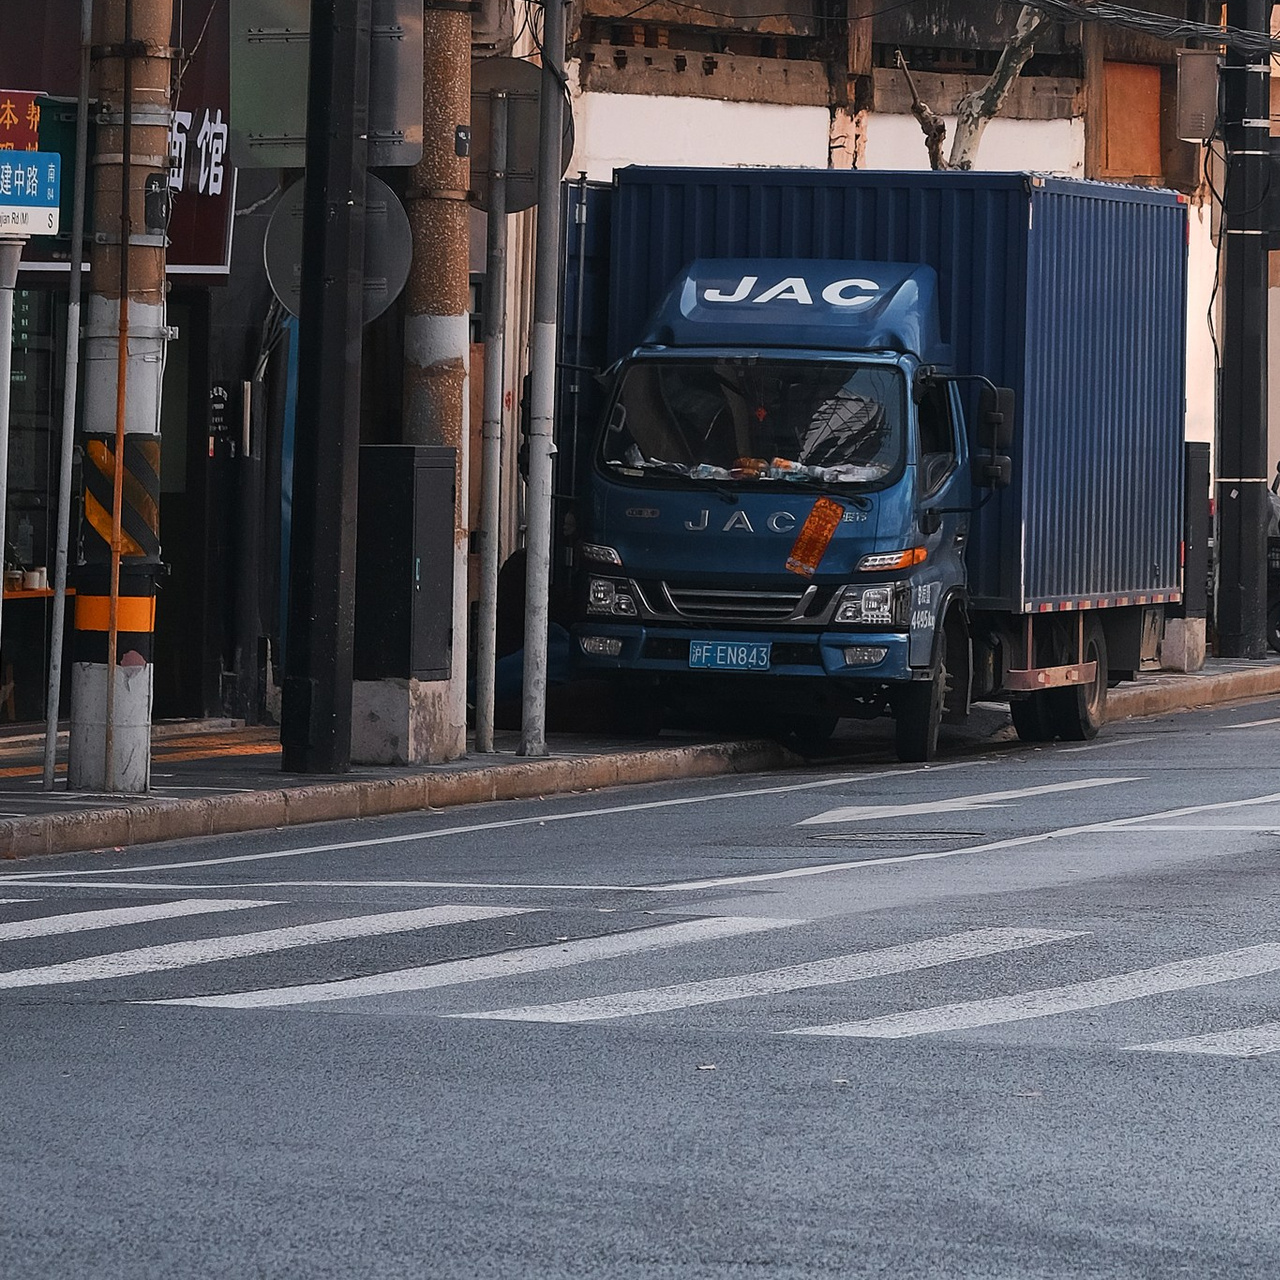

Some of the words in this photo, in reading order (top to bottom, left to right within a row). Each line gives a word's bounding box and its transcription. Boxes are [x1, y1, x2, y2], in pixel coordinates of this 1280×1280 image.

[0, 163, 38, 197] 建中路
[47, 213, 53, 229] S
[704, 276, 880, 306] JAC
[685, 509, 796, 533] JAC
